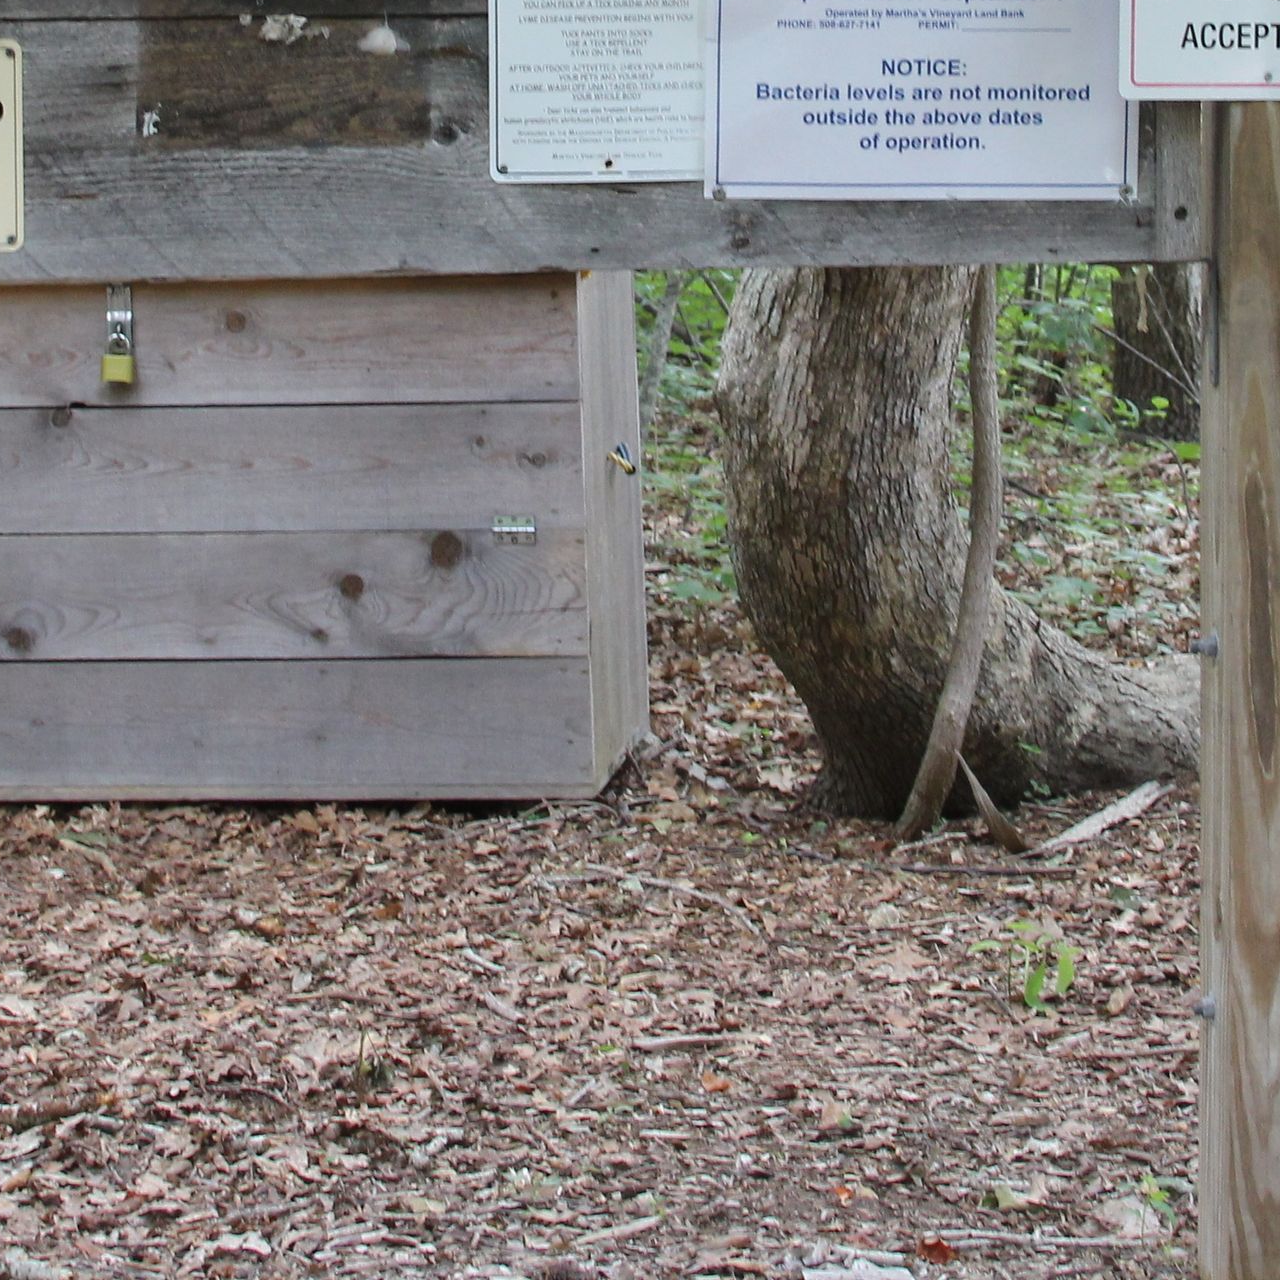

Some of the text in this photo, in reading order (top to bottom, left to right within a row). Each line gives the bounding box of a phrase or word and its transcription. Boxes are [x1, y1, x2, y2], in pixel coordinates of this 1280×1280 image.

[826, 8, 1024, 20] Operated by Martha's Vineyard Land Bank
[882, 60, 966, 76] NOTICE:
[757, 84, 1090, 101] Bacteria levels are not monitored
[803, 109, 1042, 125] outside the above dates
[860, 133, 985, 153] of operation.
